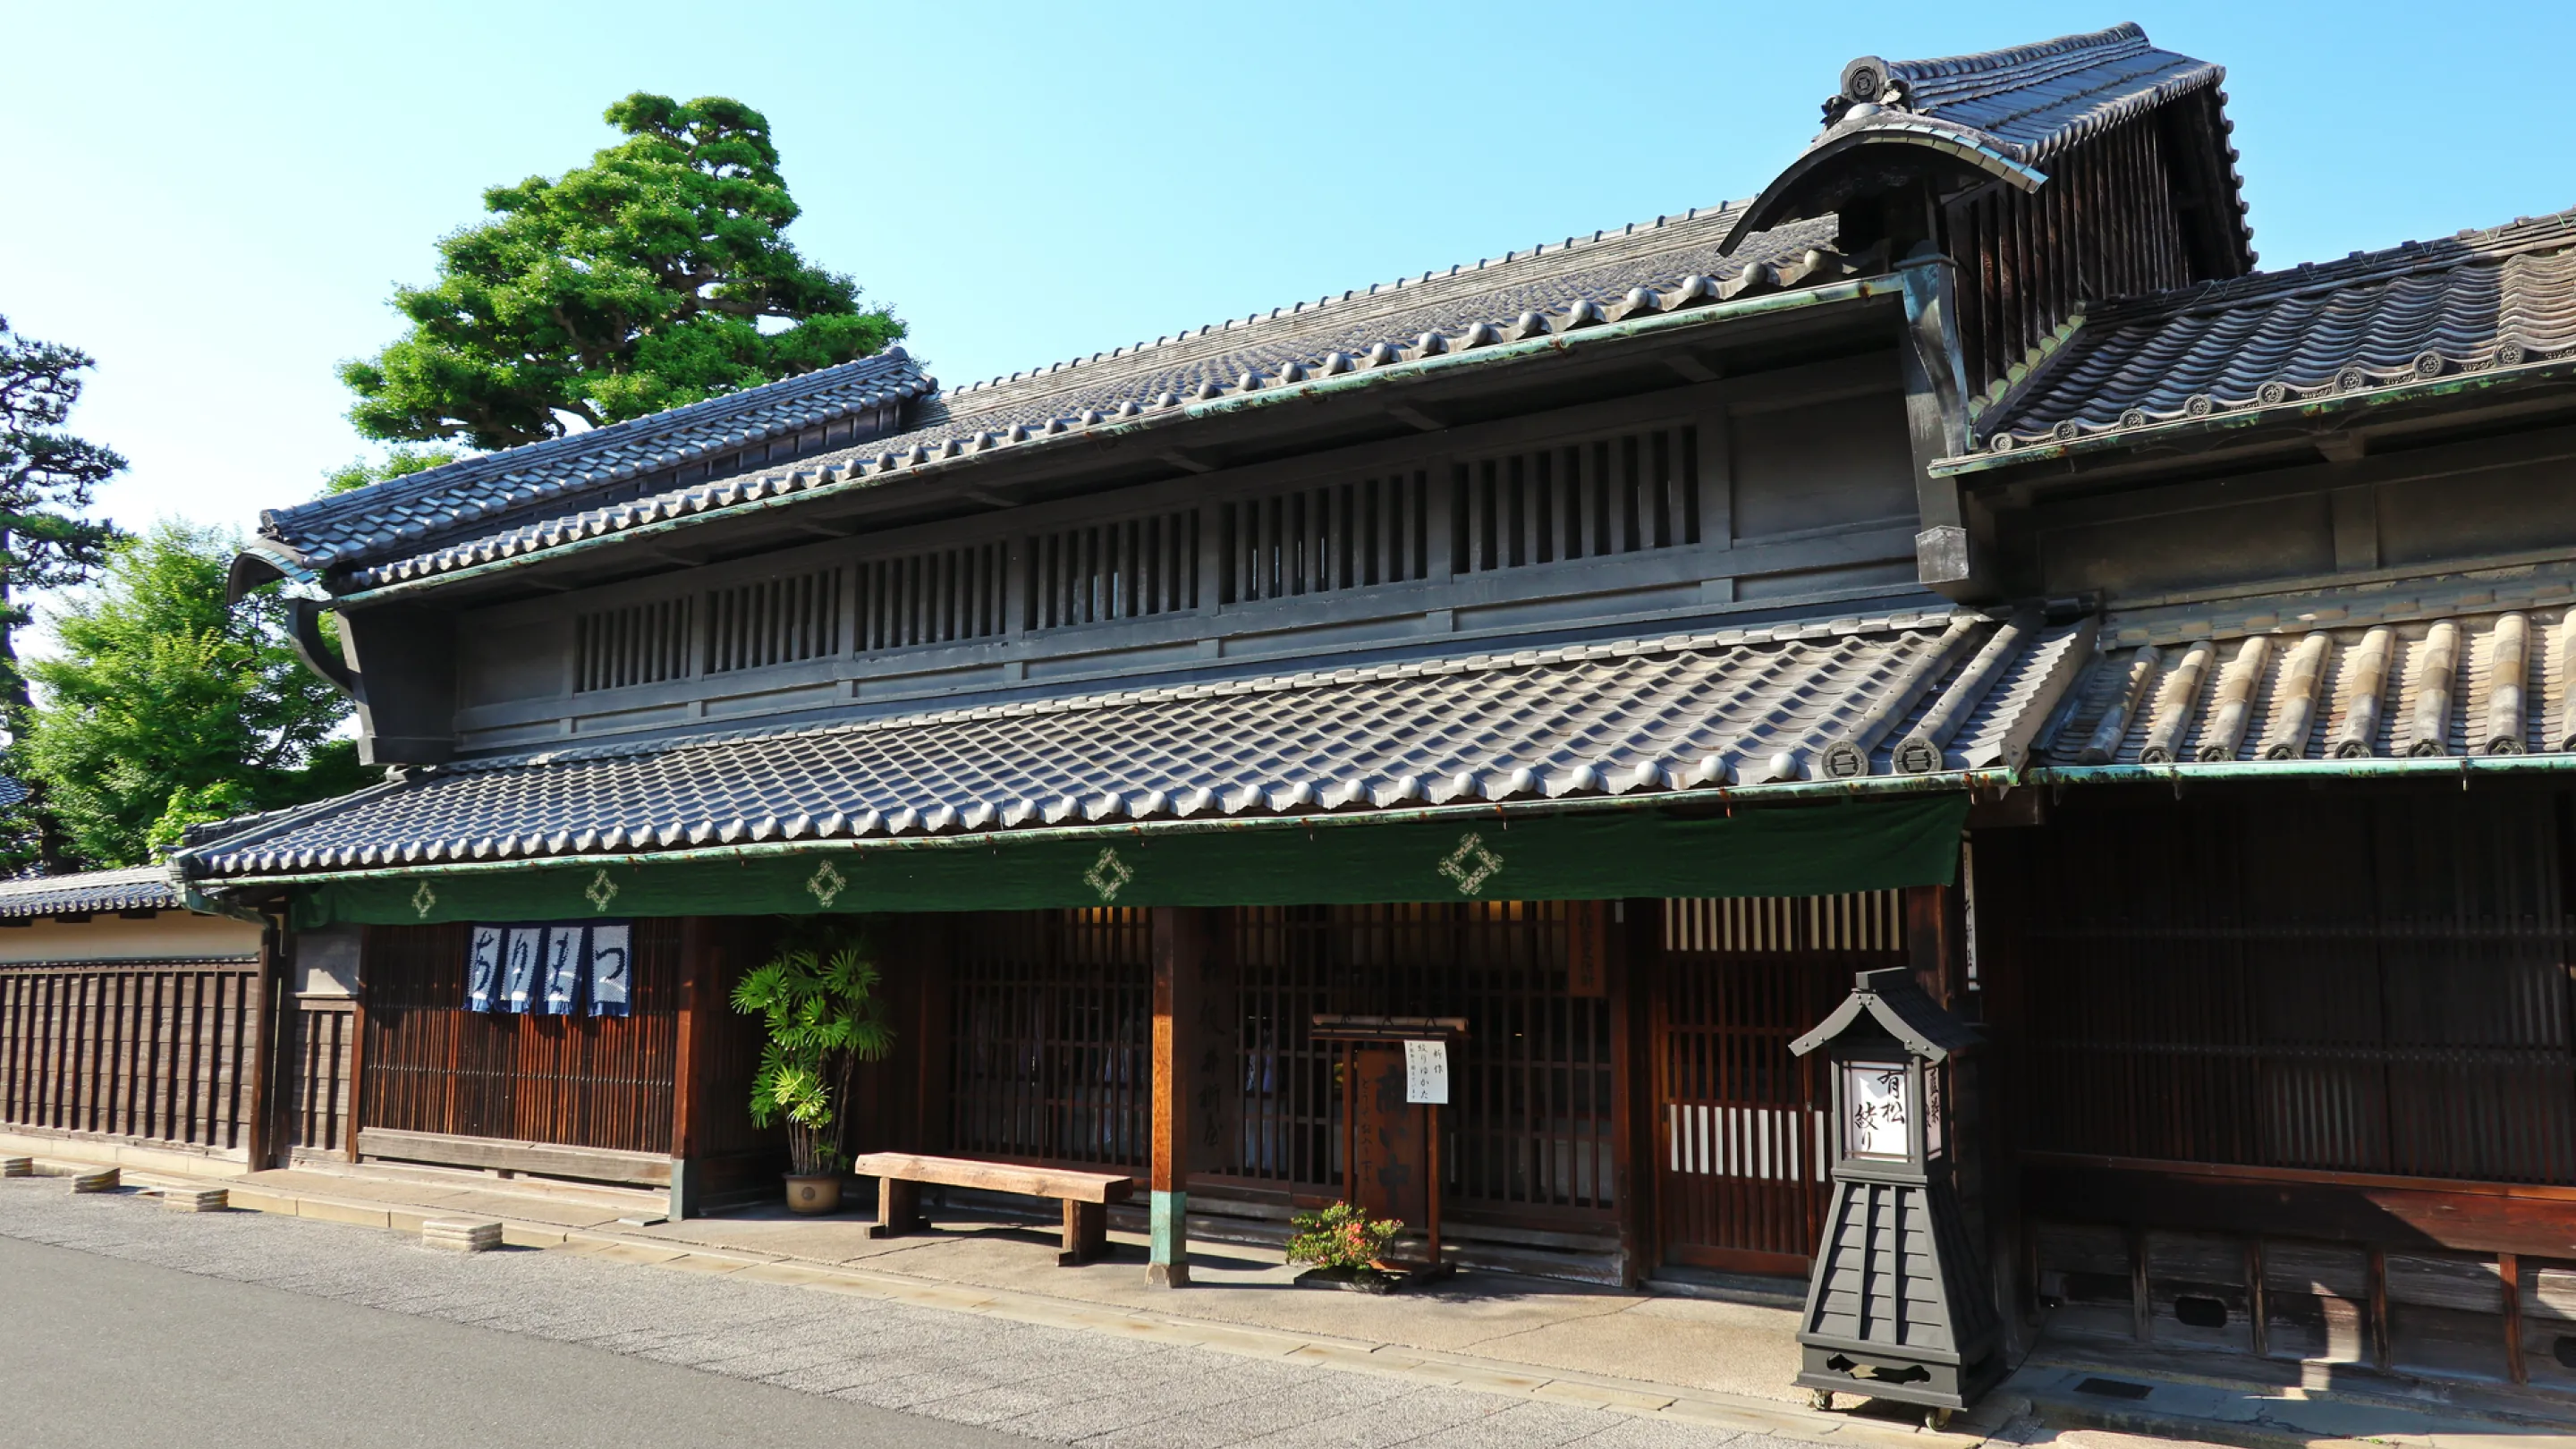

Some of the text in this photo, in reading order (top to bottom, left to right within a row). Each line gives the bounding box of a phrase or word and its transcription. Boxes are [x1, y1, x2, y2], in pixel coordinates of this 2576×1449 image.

[1418, 1044, 1429, 1099] 絞りゆかた
[1877, 1071, 1905, 1124] 有松
[1854, 1101, 1879, 1150] 絞り
